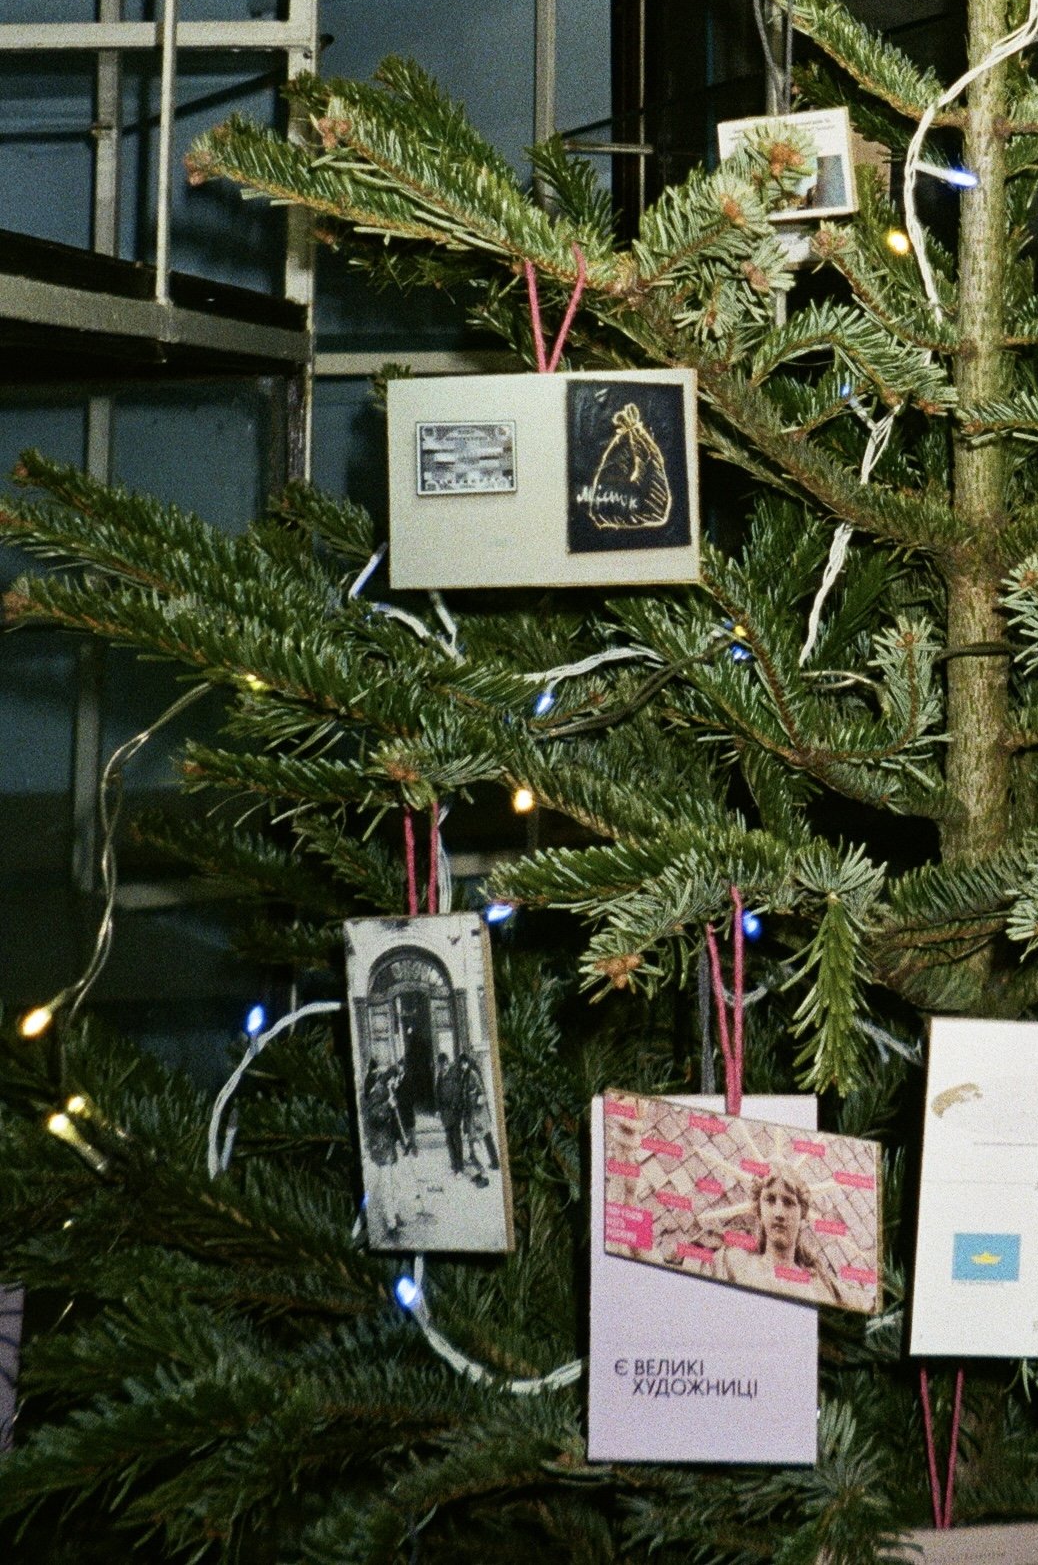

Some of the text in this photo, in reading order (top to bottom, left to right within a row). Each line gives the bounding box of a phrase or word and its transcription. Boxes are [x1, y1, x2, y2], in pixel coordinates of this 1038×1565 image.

[614, 1359, 704, 1376] Є ВЕЛИКІ
[632, 1378, 758, 1398] ХУДОЖНИЦІ
